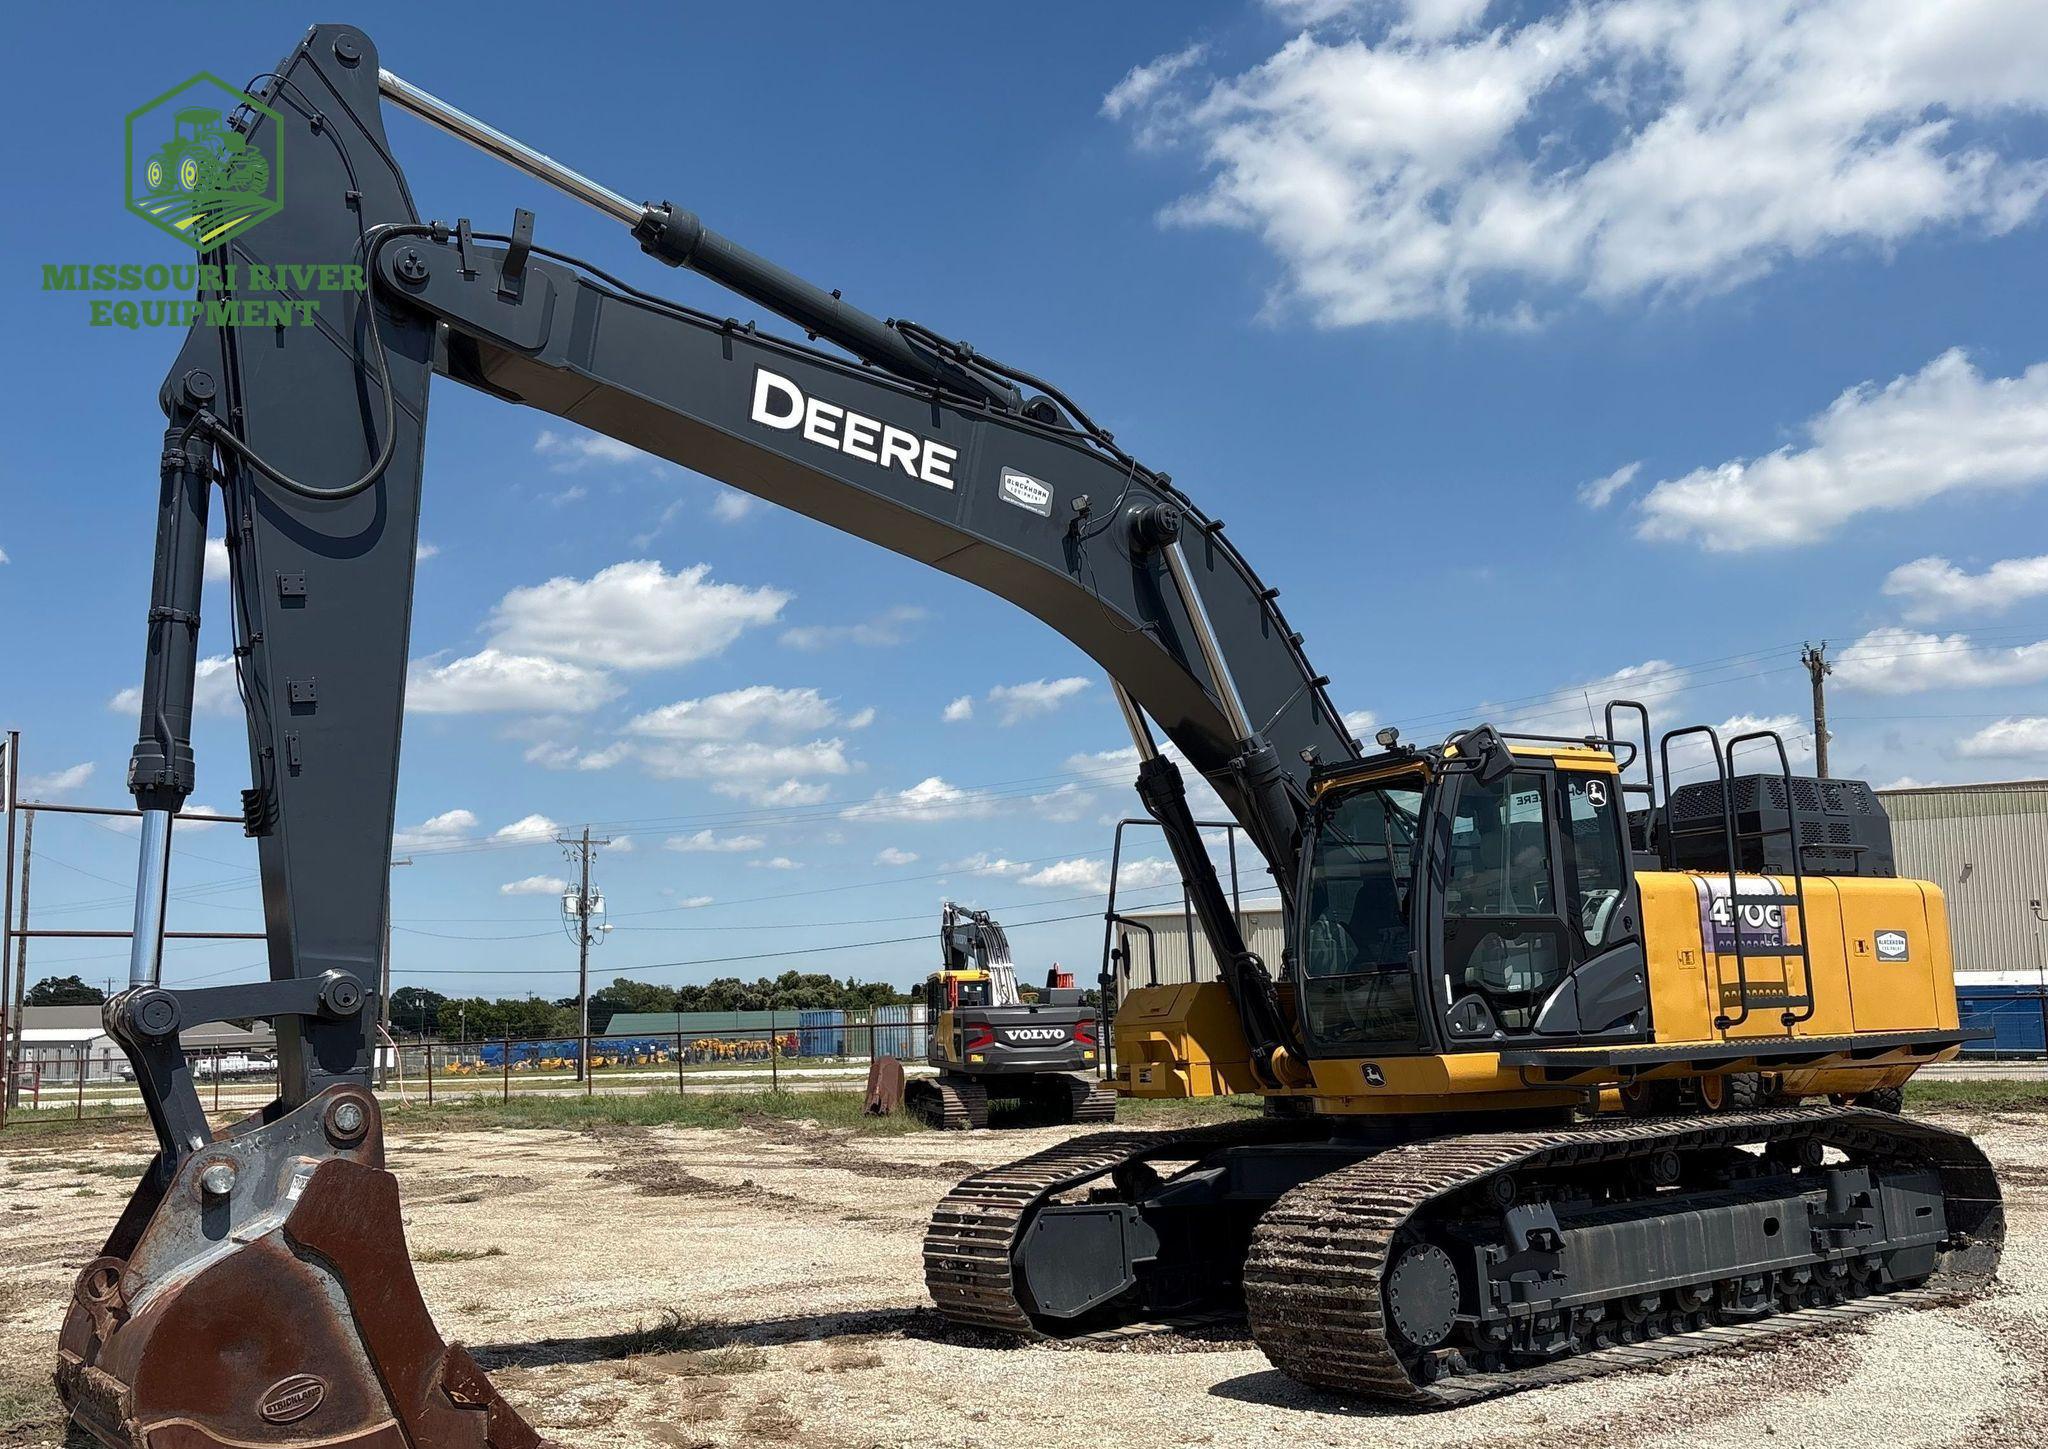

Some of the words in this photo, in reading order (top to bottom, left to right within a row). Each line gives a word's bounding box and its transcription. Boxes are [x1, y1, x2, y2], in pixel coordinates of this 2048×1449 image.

[751, 368, 958, 490] DEERE
[1006, 477, 1047, 498] BLACKHORN
[1005, 1028, 1066, 1041] VOLVO
[265, 1386, 322, 1414] STRICKLAND
